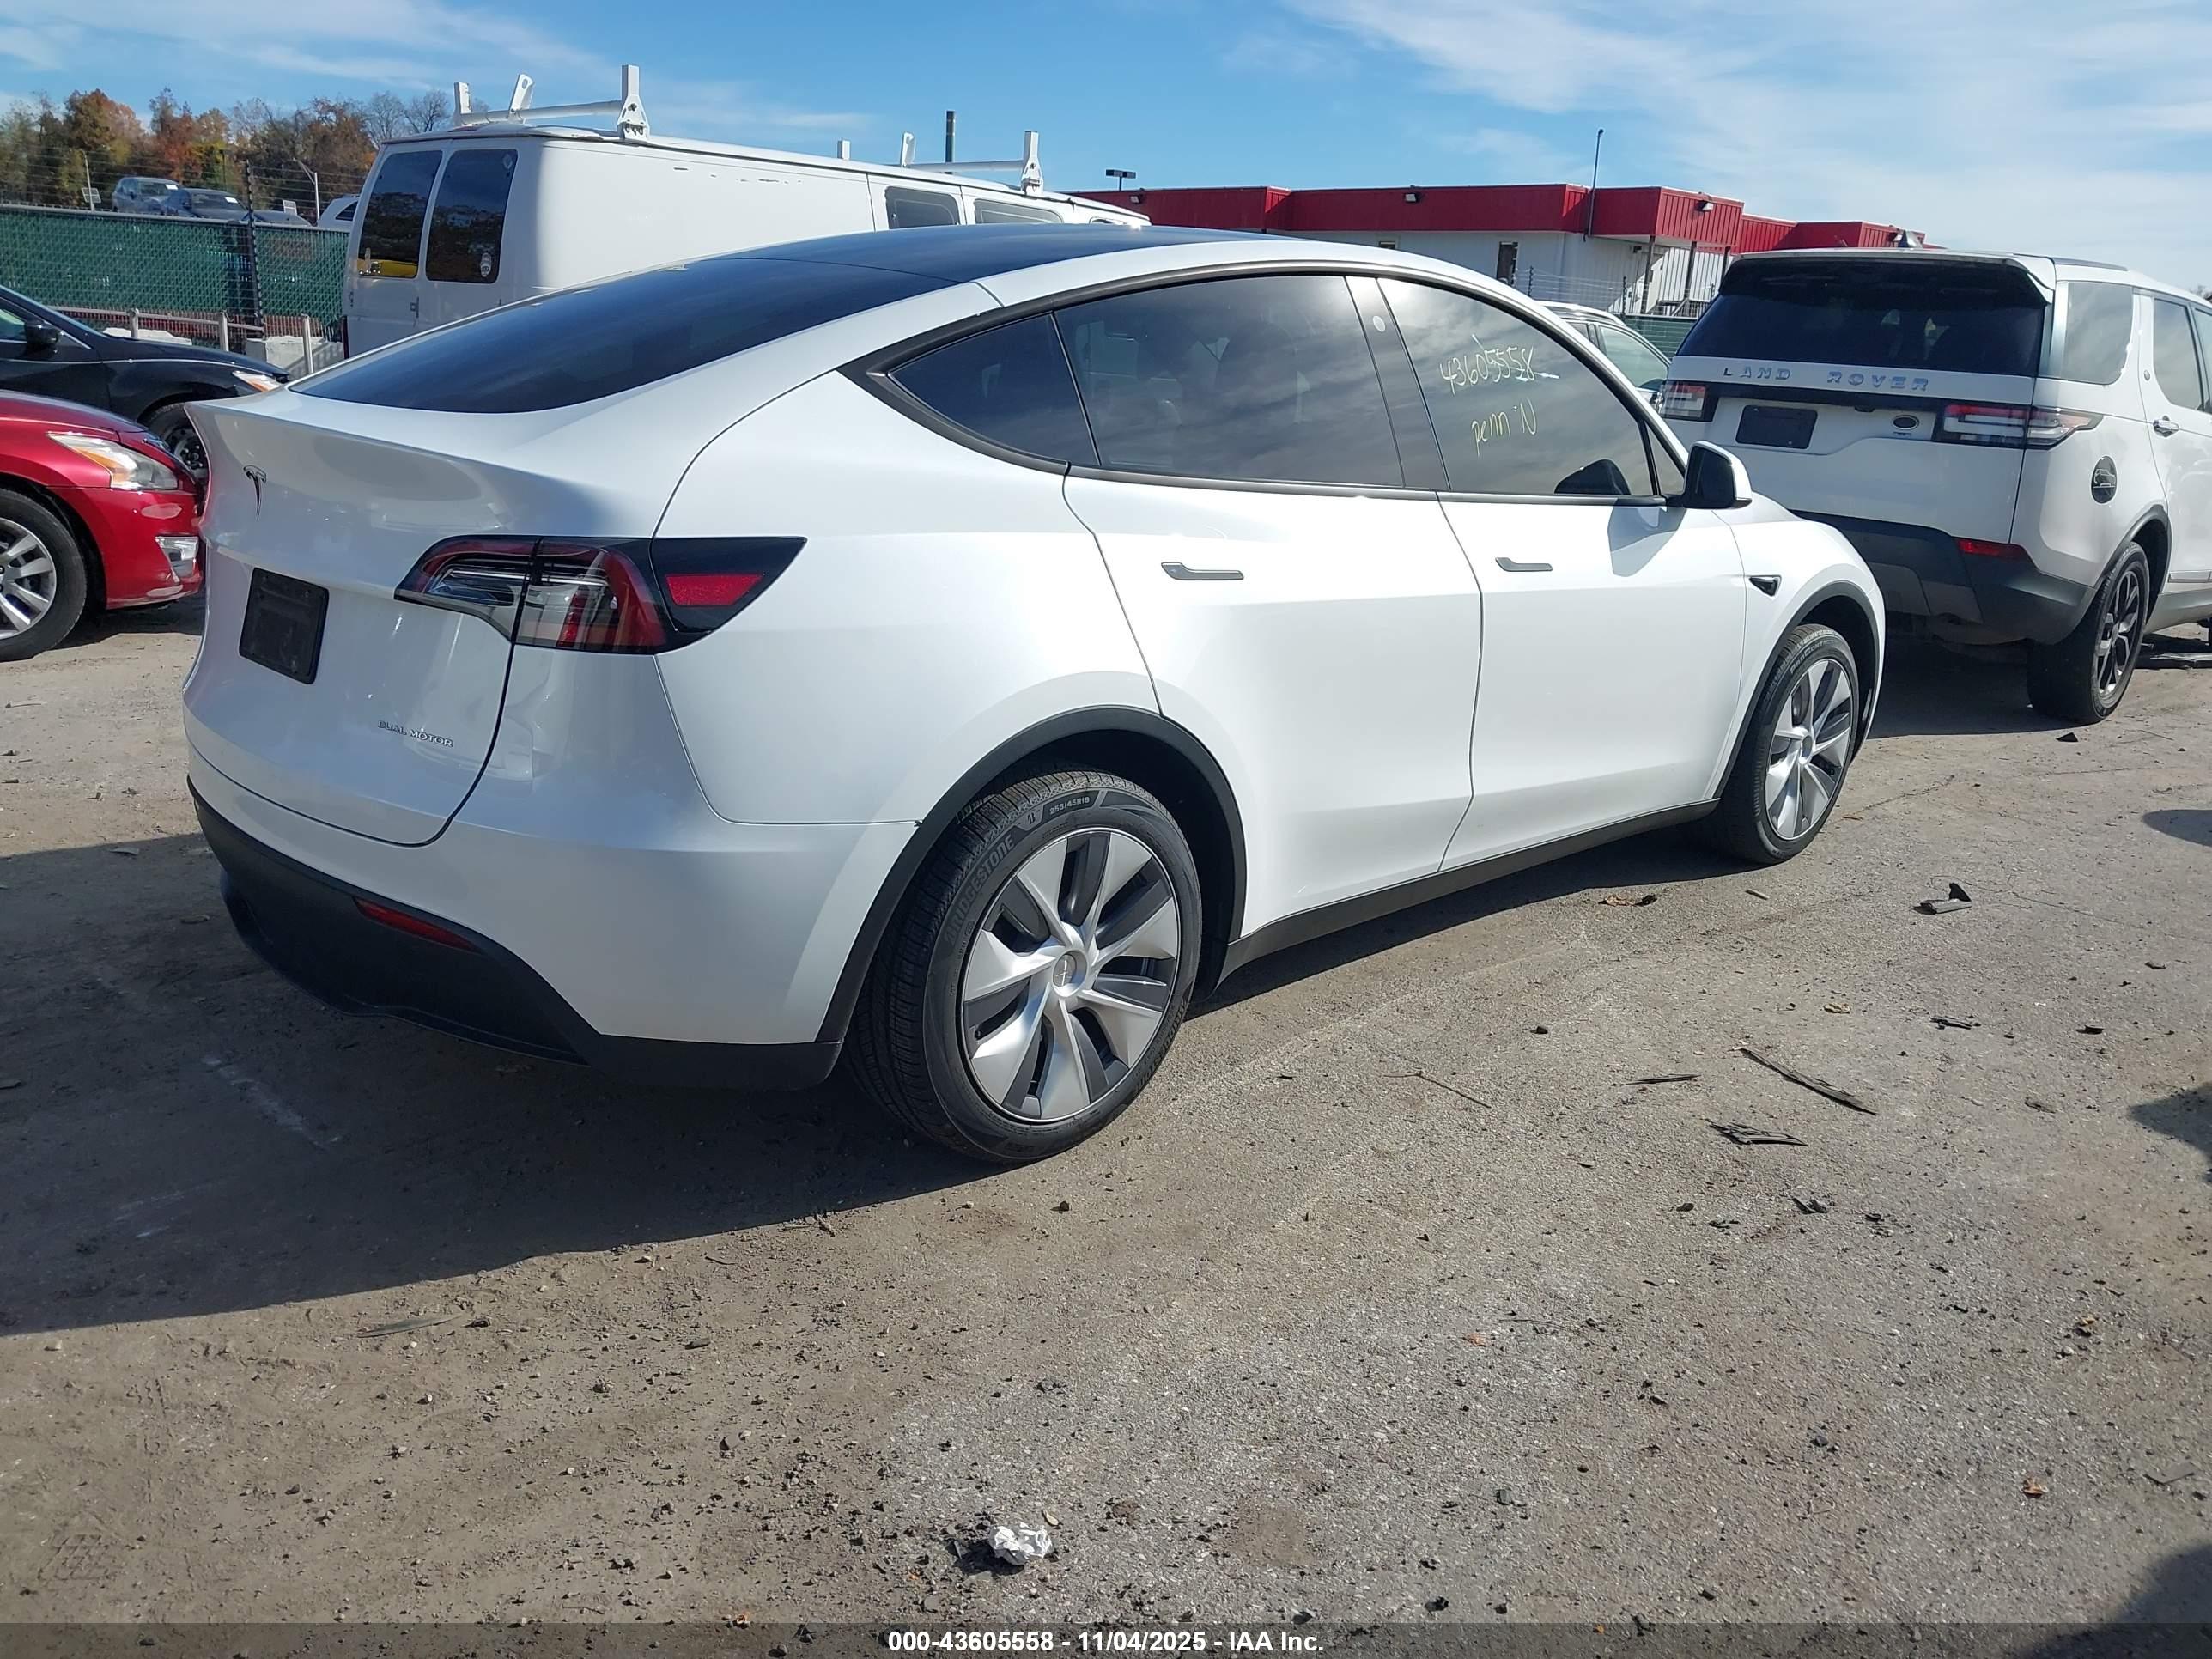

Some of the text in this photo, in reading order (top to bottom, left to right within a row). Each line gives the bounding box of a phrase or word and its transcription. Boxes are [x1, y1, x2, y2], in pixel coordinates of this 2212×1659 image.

[1440, 342, 1544, 396] 43605558
[1723, 366, 1929, 392] LAND ROVER
[378, 720, 454, 748] DUAL MOTOR
[945, 833, 1017, 945] BRIDGESTONE
